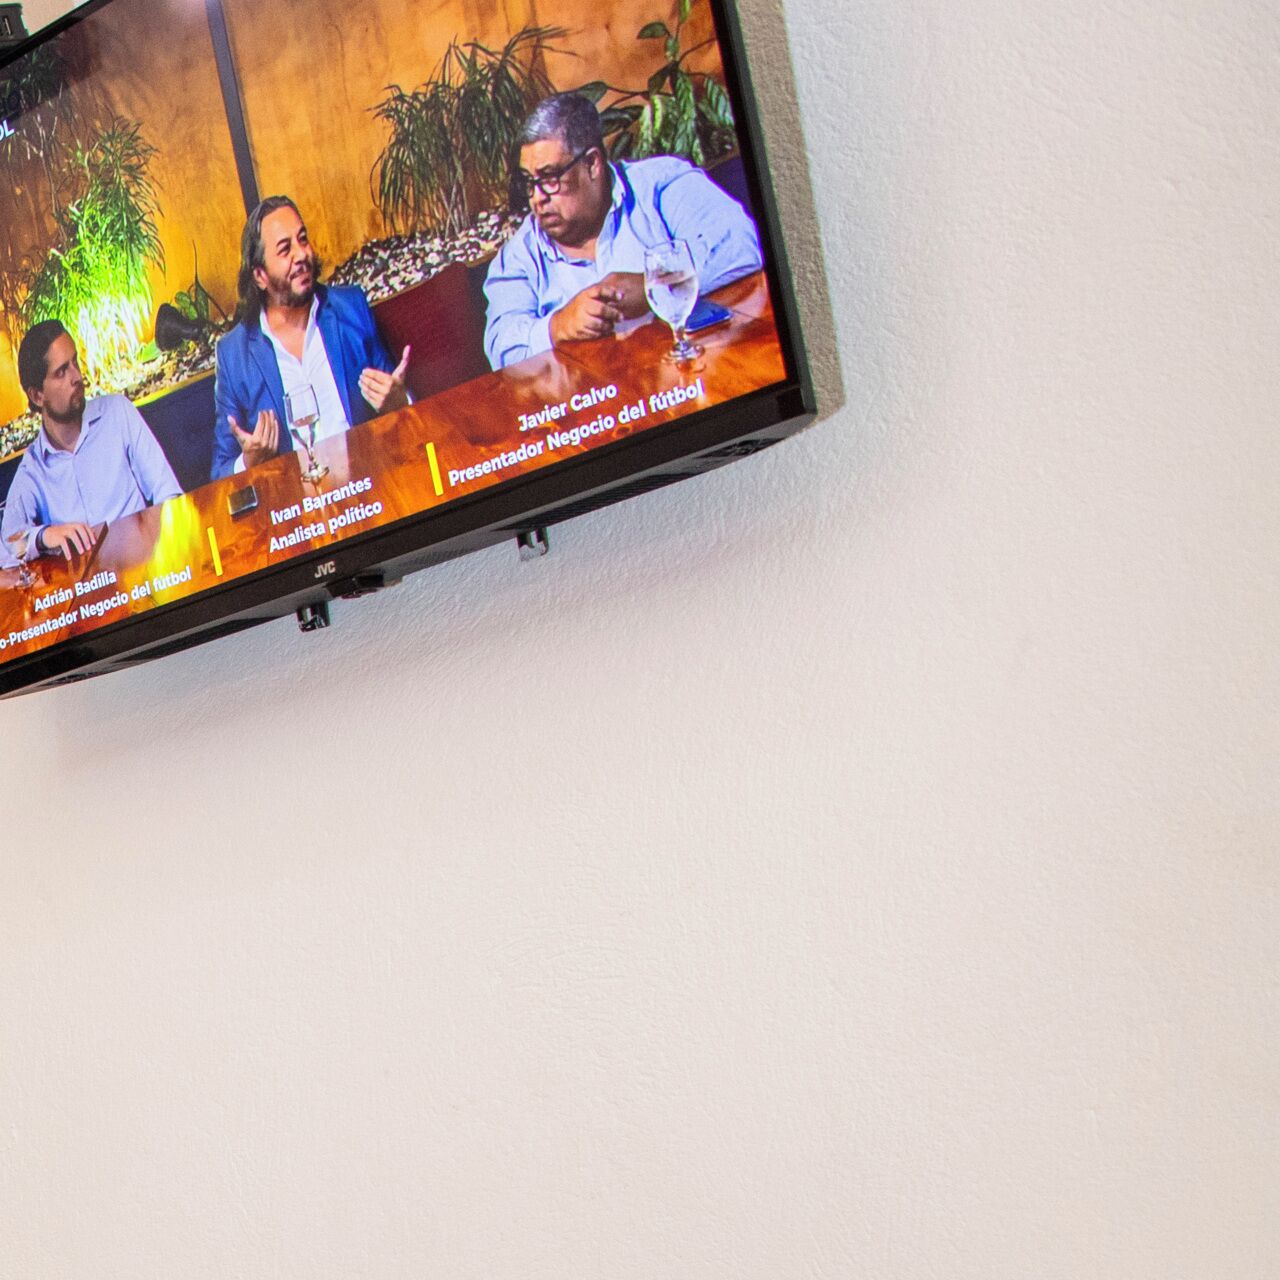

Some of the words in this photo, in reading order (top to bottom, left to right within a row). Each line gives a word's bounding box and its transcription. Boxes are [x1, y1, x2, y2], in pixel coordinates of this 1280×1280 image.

[518, 401, 567, 432] Javier
[570, 384, 618, 412] Calvo
[448, 439, 544, 487] Presentador
[547, 414, 615, 450] Negocio
[618, 400, 646, 425] del
[649, 378, 704, 414] fútbol
[270, 504, 301, 526] Ivan
[303, 476, 372, 513] Barrantes
[269, 523, 326, 553] Analista
[328, 501, 383, 534] político
[34, 587, 73, 612] Adrián
[74, 570, 117, 596] Badilla
[314, 560, 336, 579] JVC
[80, 593, 129, 621] Negocio
[131, 581, 151, 601] del
